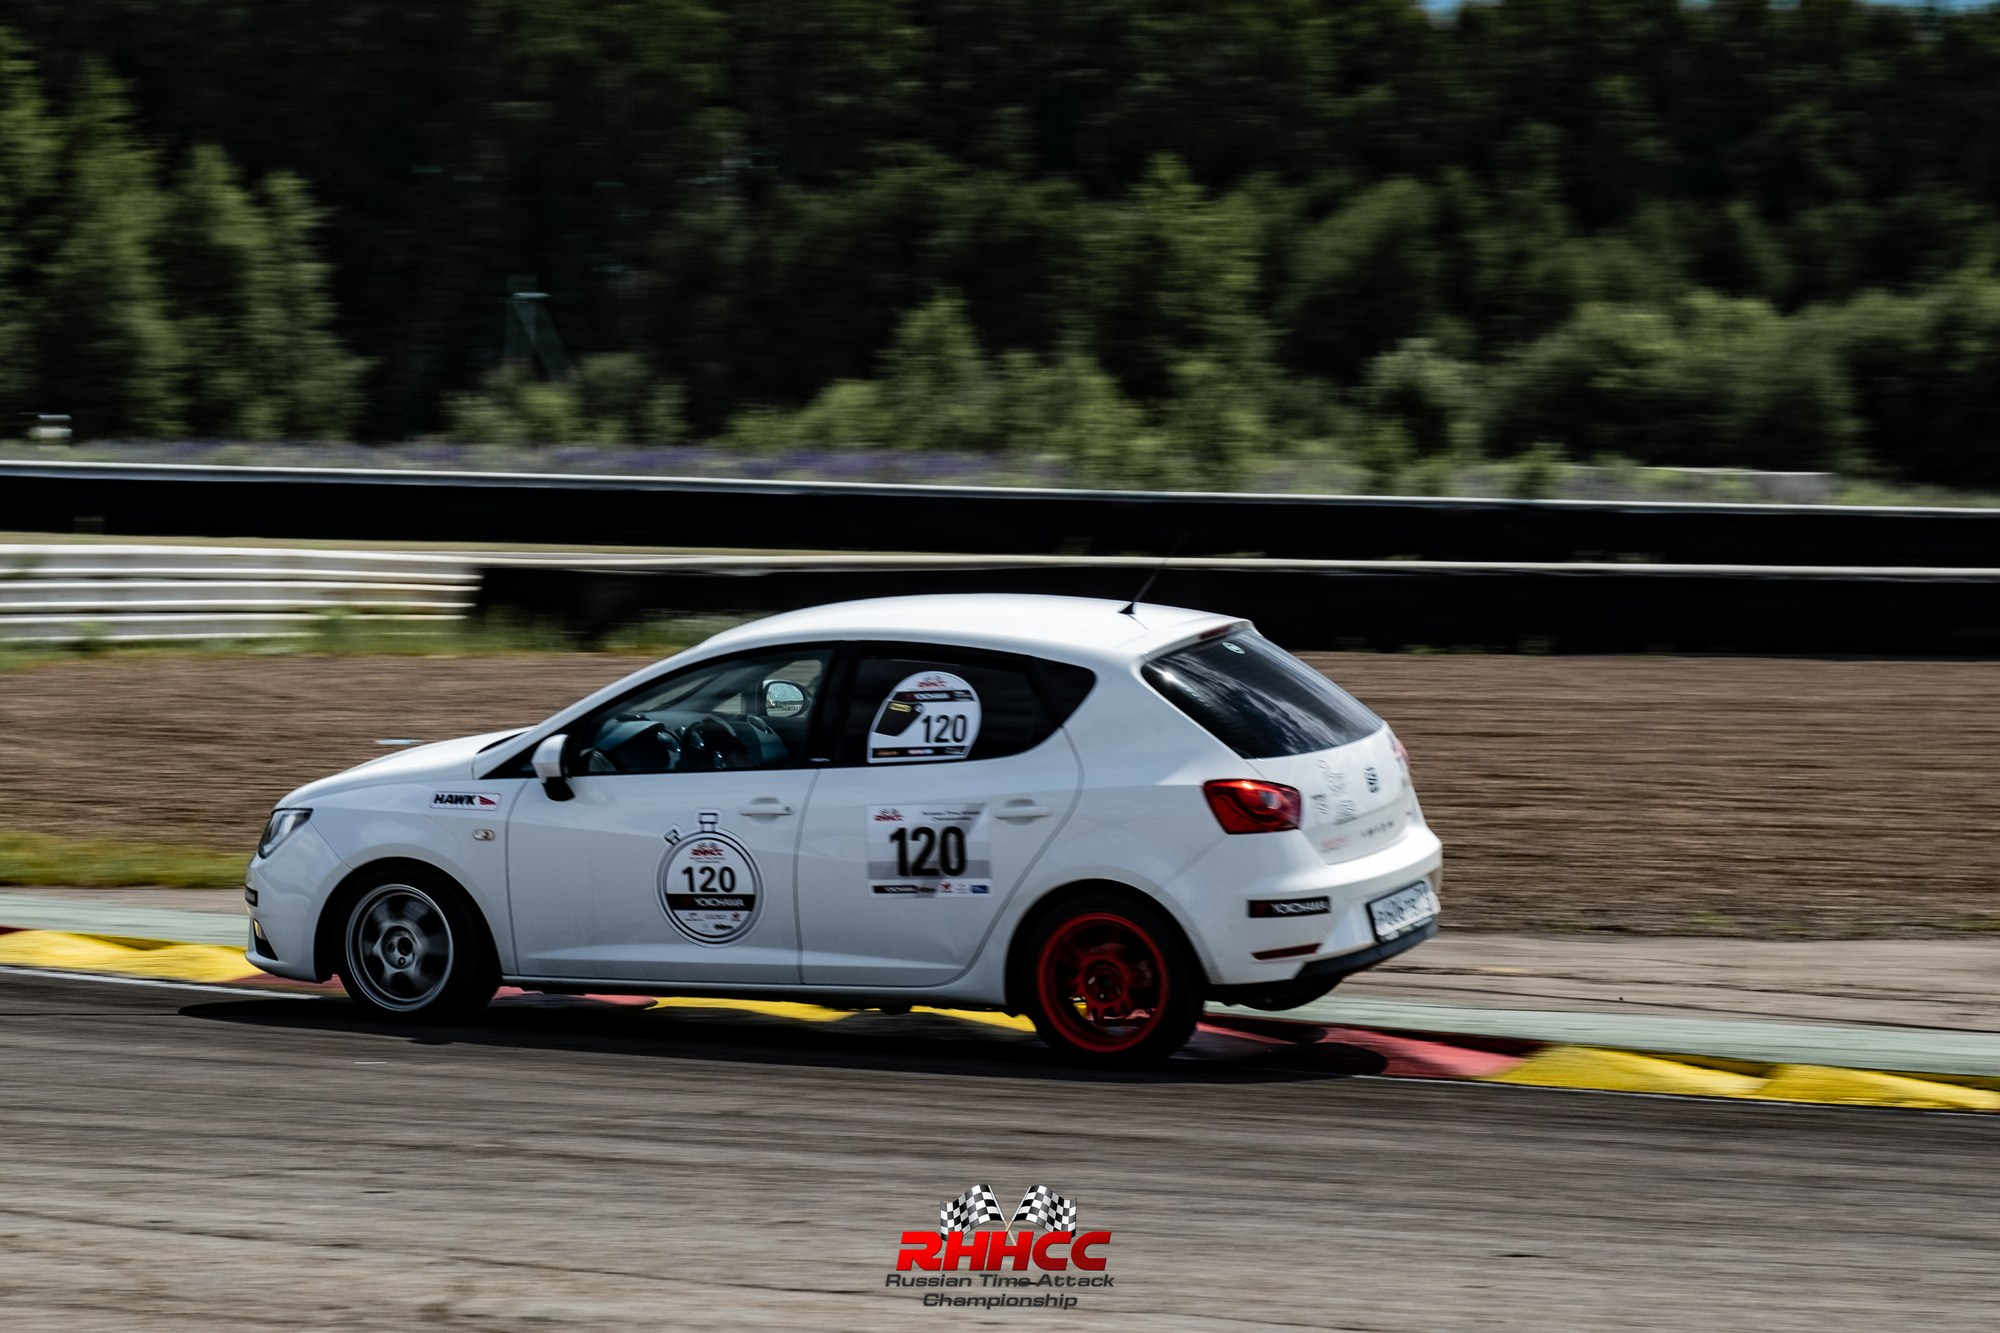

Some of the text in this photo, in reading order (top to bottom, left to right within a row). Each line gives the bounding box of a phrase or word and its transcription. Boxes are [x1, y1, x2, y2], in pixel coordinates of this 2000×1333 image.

[922, 714, 968, 744] 120
[434, 793, 477, 806] HAWK
[890, 826, 967, 877] 120
[682, 866, 736, 893] 120
